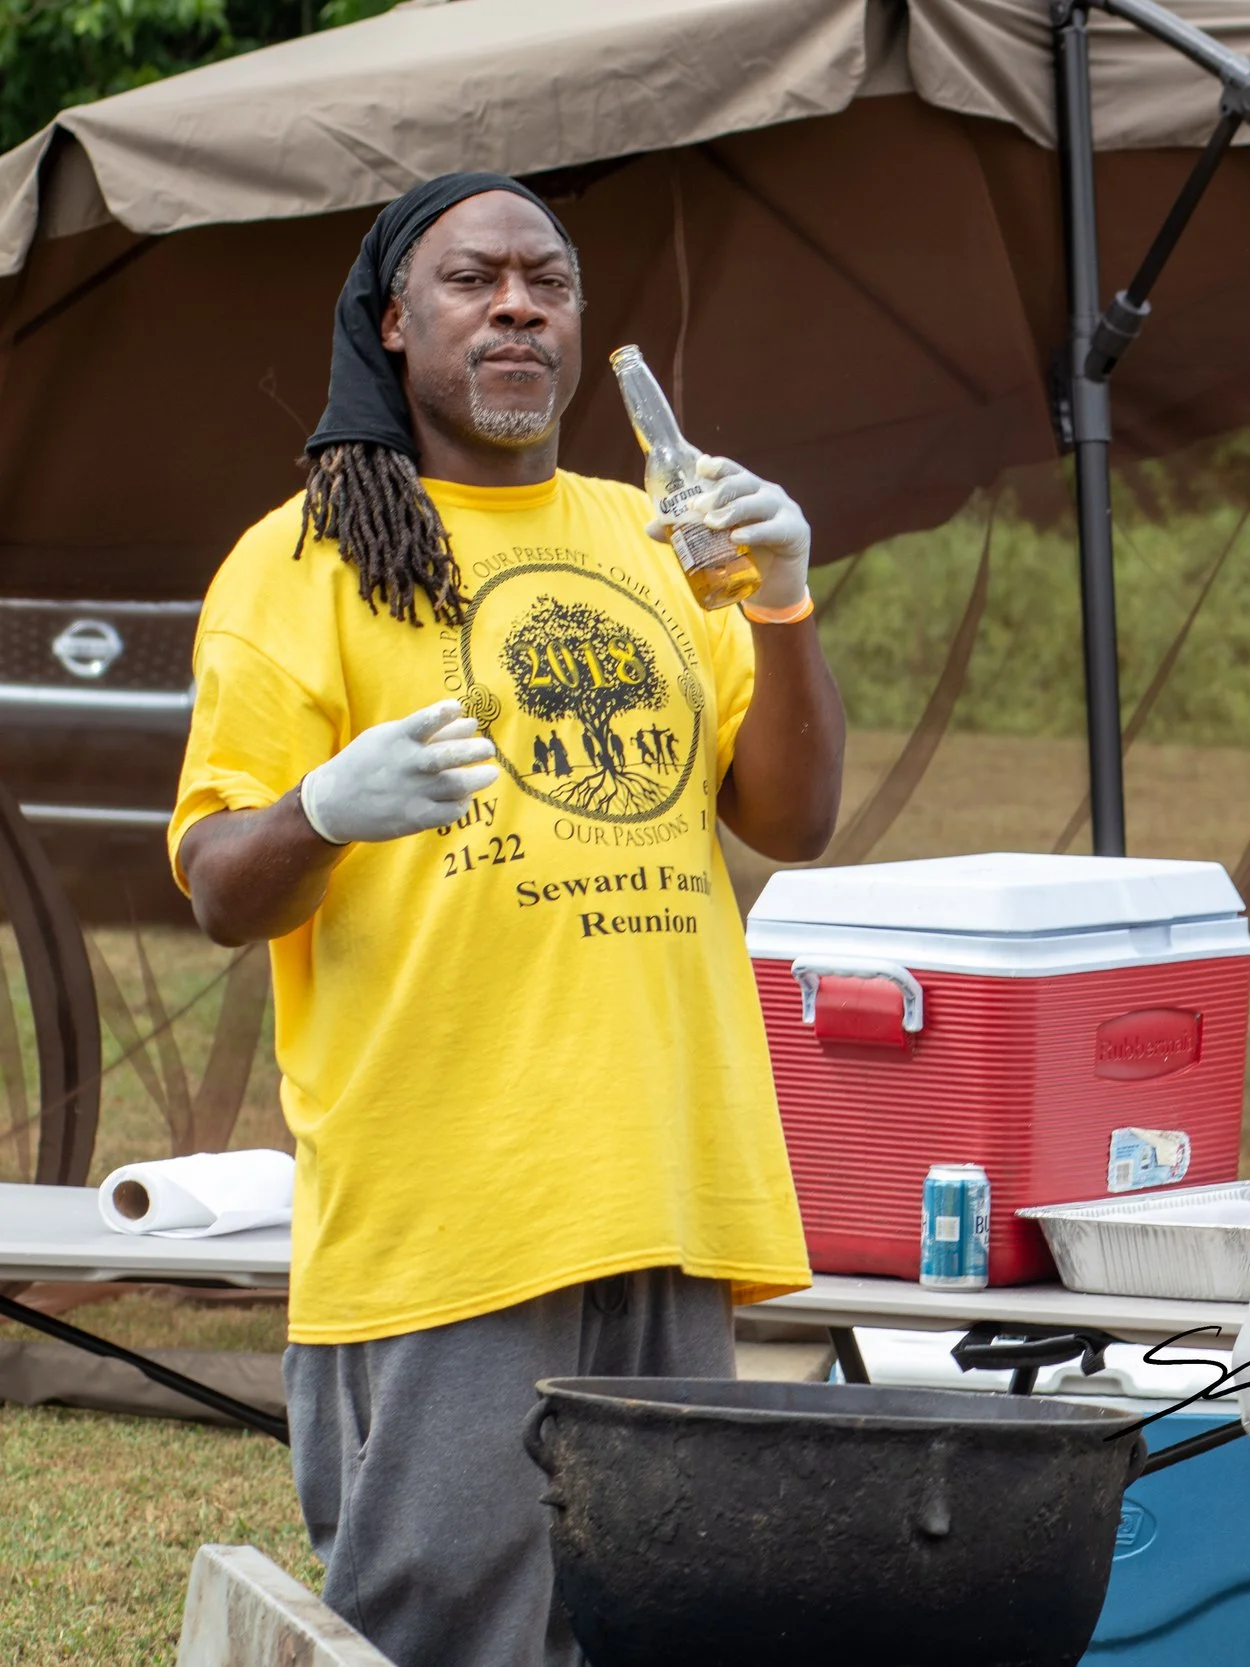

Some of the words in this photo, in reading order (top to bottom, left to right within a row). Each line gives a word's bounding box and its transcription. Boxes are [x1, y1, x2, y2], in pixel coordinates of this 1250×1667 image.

[472, 552, 514, 579] OUR
[512, 546, 588, 566] PRESENT
[442, 647, 463, 692] OUR
[514, 637, 647, 690] 2018
[553, 818, 611, 847] OUR
[612, 814, 689, 848] PASSIONS
[444, 833, 525, 878] 21-22
[516, 866, 648, 909] Seward
[579, 907, 698, 938] Reunion
